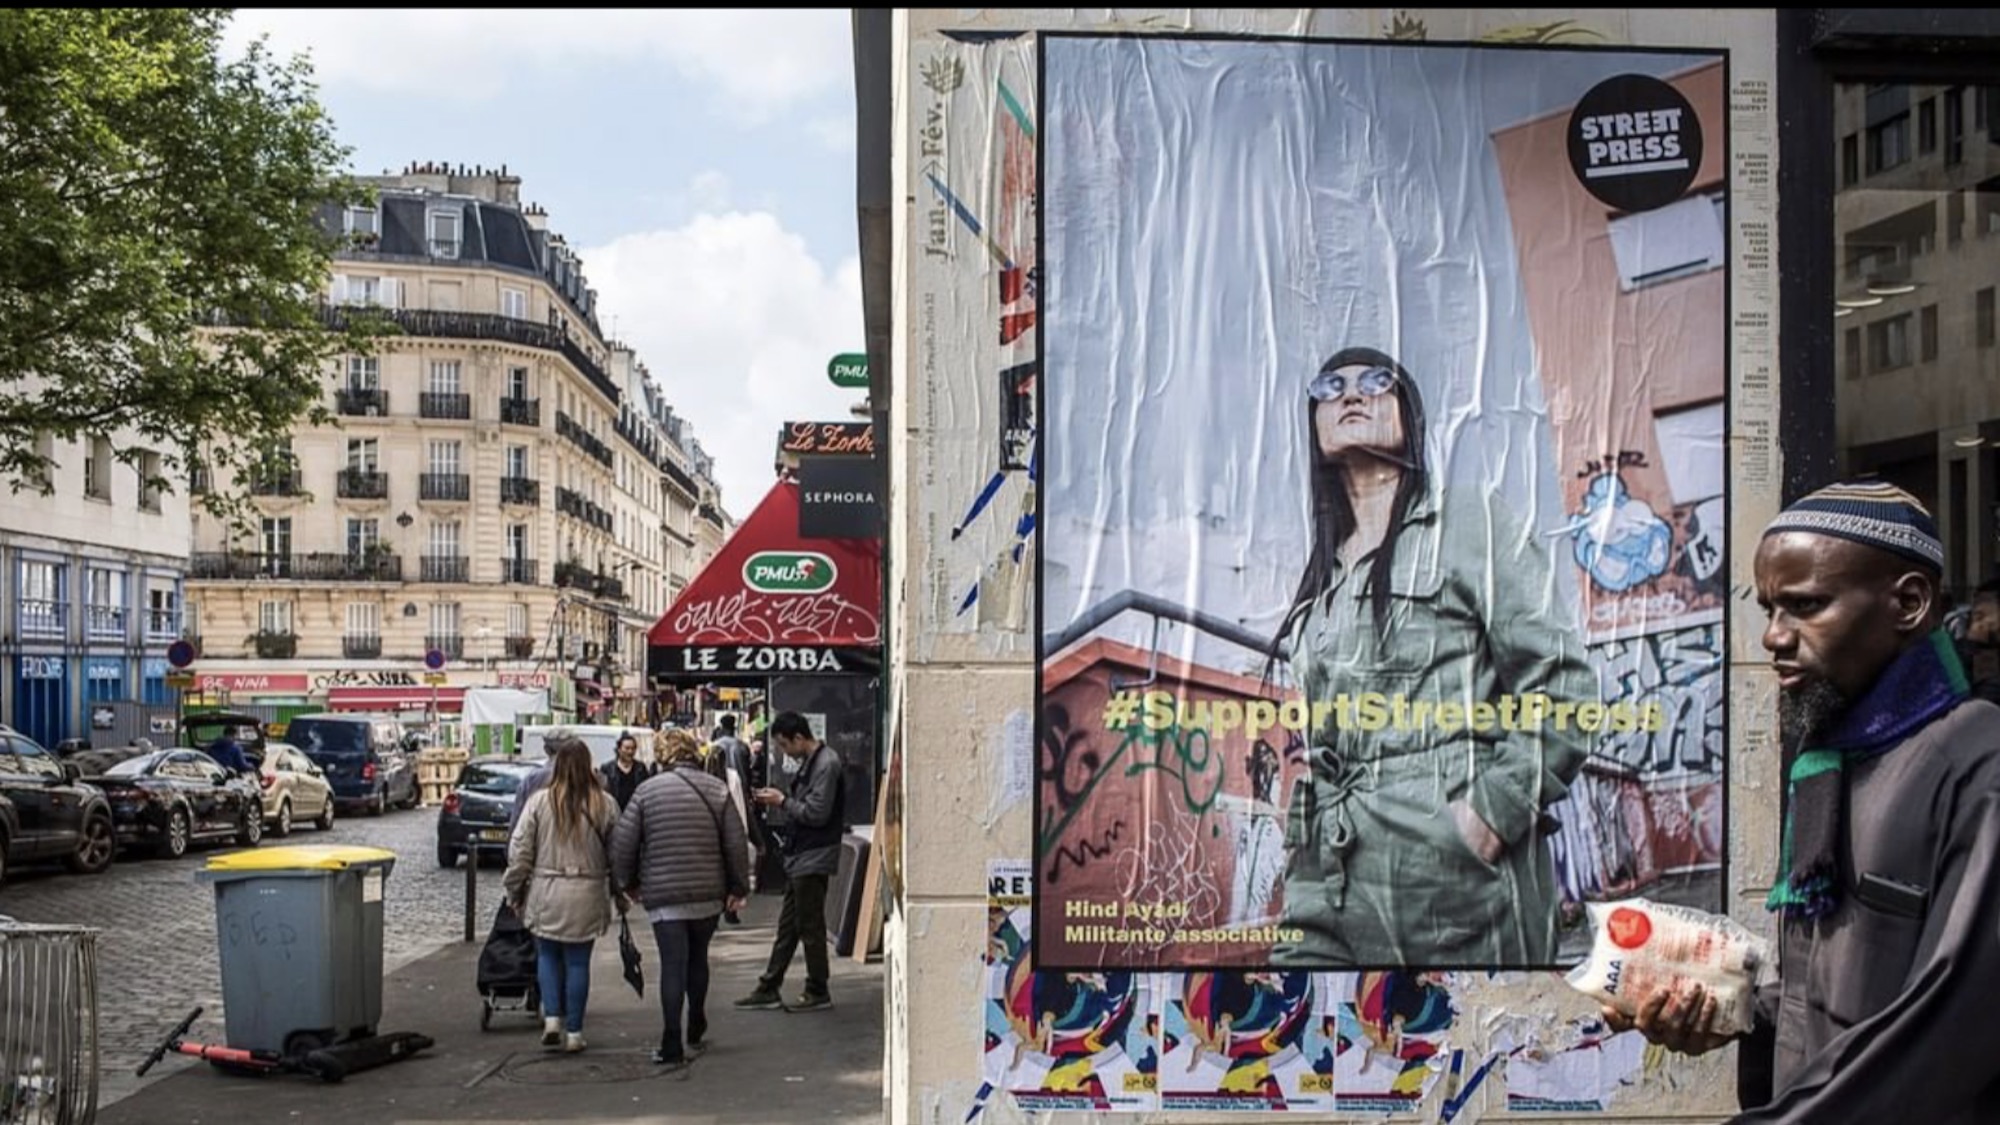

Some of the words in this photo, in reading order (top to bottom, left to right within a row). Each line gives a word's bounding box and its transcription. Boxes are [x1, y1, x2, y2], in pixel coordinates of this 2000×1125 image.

[920, 101, 943, 157] Fév.
[1581, 108, 1683, 139] STREET
[1587, 134, 1681, 166] PRESS
[924, 200, 948, 261] Jan.
[833, 364, 868, 378] PMU
[784, 421, 816, 451] Le
[817, 424, 875, 452] Zorb
[804, 492, 875, 505] SEPHORA
[753, 564, 796, 582] PMU
[683, 647, 719, 671] LE
[735, 646, 842, 671] ZORBA
[1102, 690, 1665, 740] #SupportStreetPress
[994, 876, 1033, 895] RE
[1065, 900, 1118, 918] Hind
[1125, 900, 1189, 921] Ayadi
[1065, 925, 1167, 943] Militante
[1174, 925, 1305, 943] associative
[1604, 959, 1622, 996] AAA
